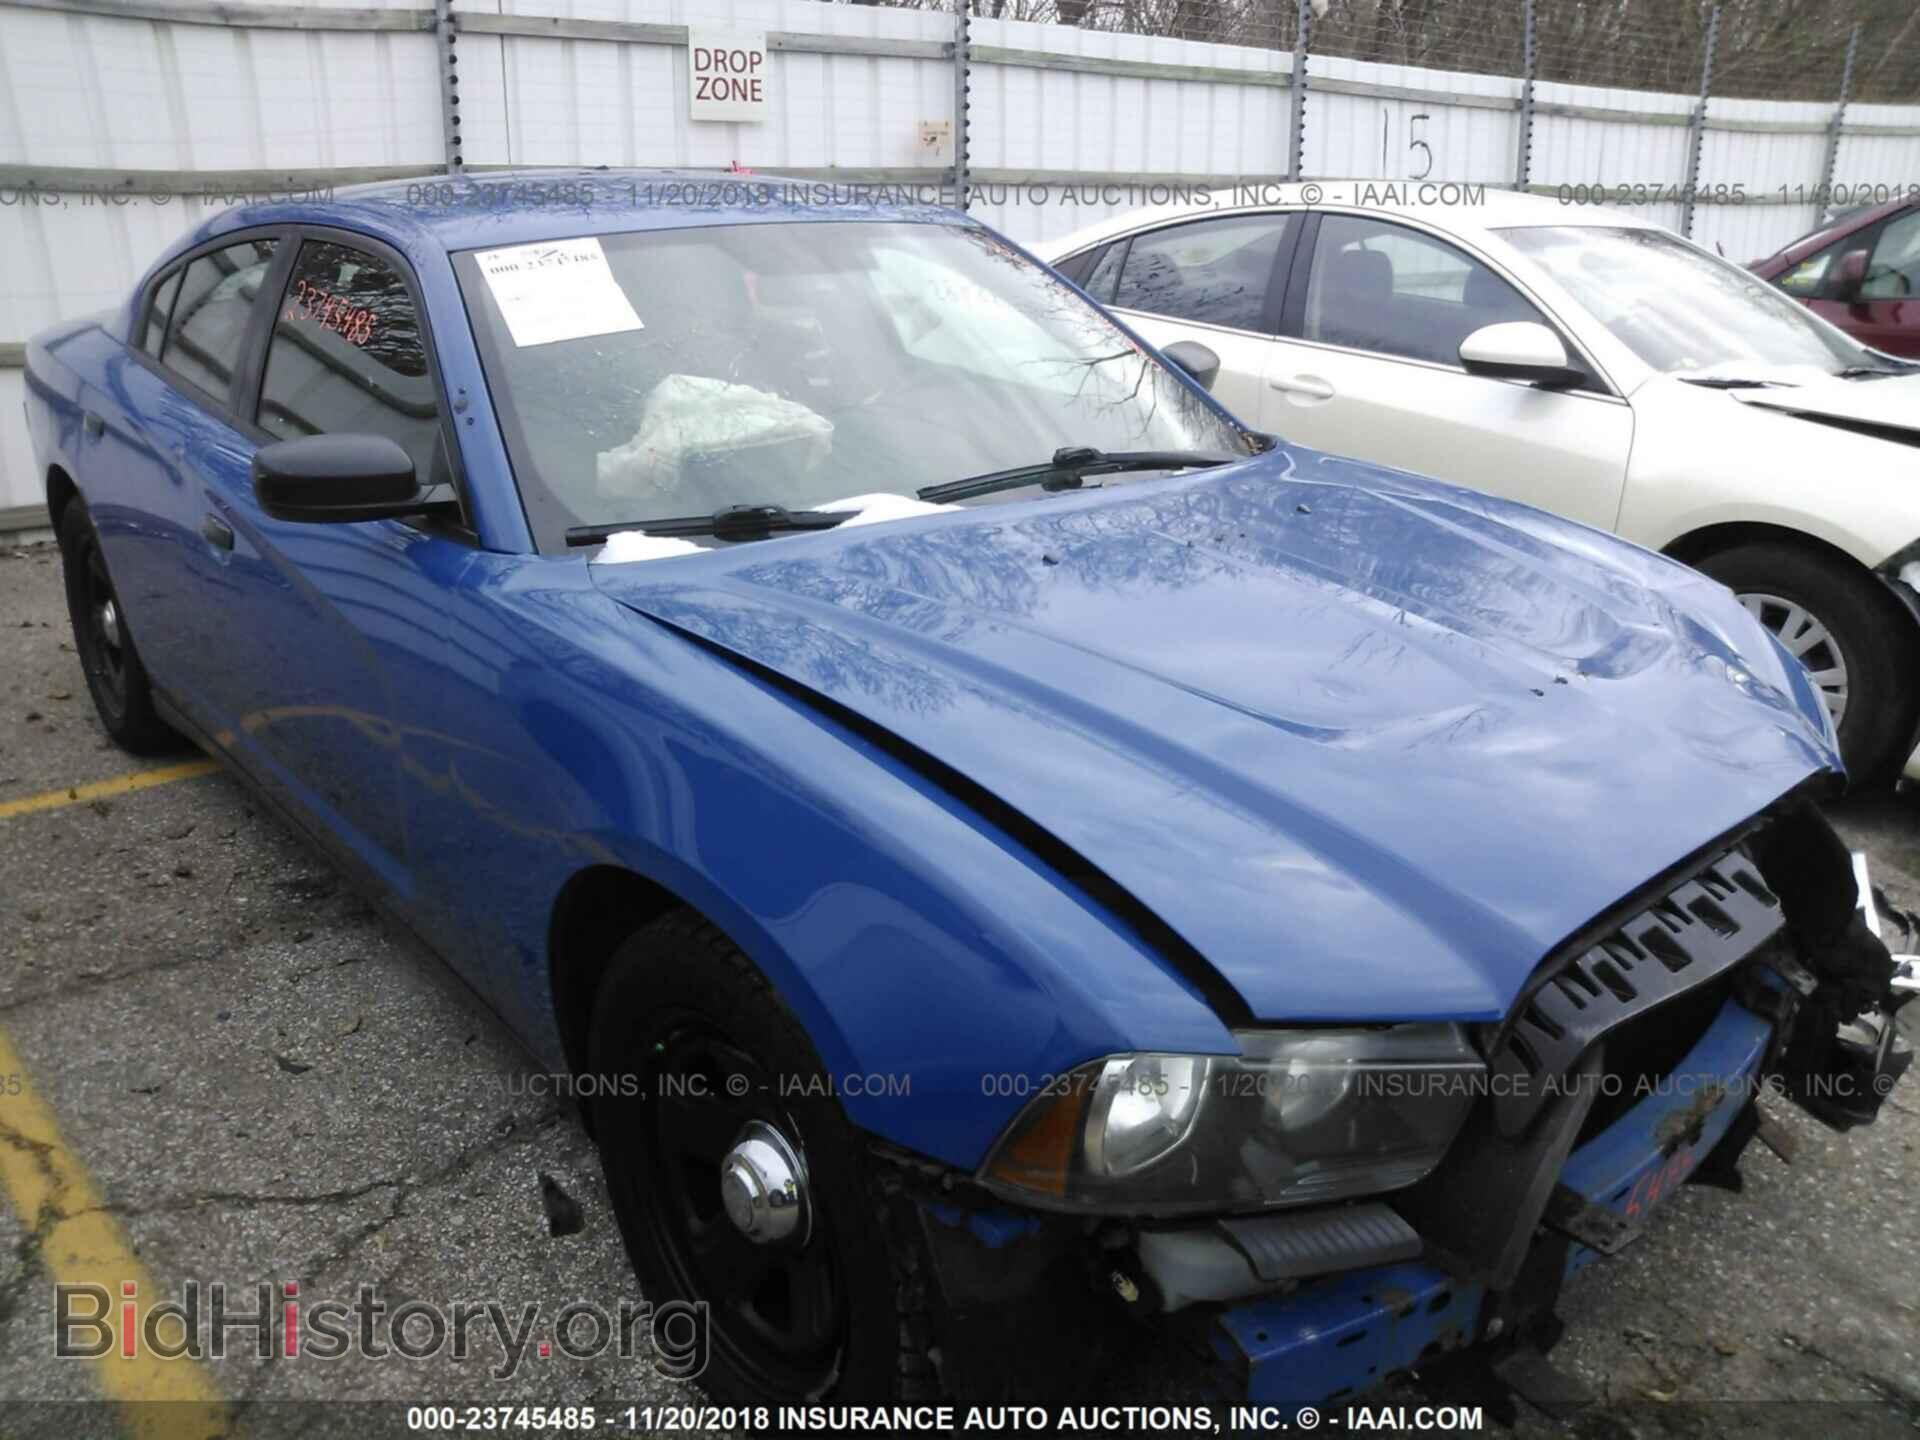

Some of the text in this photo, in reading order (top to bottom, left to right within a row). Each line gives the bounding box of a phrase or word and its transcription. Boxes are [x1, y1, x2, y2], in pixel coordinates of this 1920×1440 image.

[693, 48, 763, 73] DROP
[695, 76, 763, 102] ZONE
[1383, 108, 1433, 180] 15
